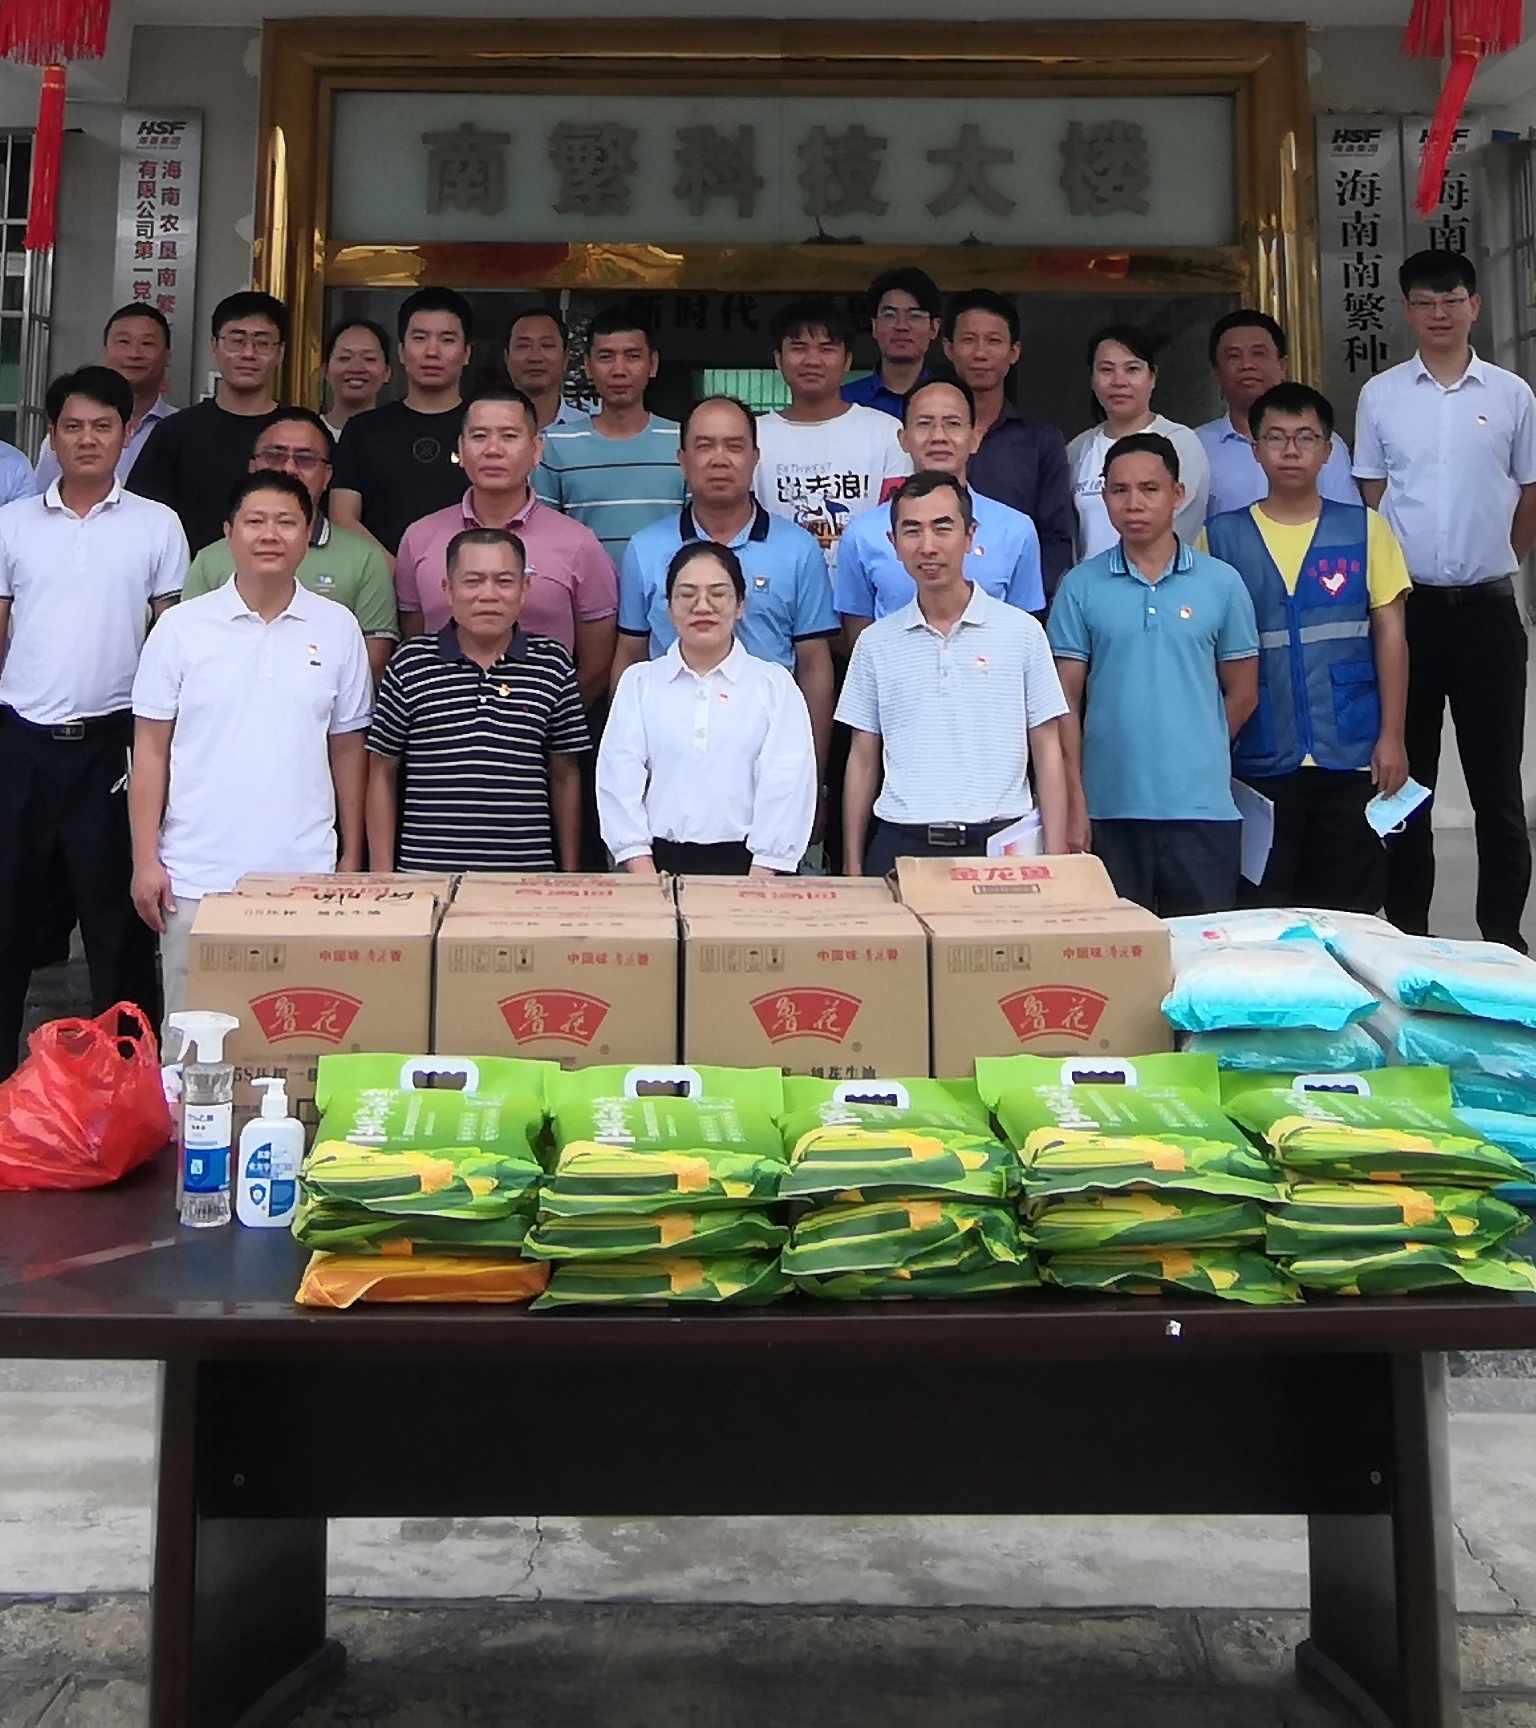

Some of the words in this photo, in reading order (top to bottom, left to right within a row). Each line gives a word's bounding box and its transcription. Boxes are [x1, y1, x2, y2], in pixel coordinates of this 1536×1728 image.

[137, 121, 187, 135] HSF
[1331, 128, 1382, 143] HSF
[421, 121, 1153, 218] 南繁科技大楼
[1335, 169, 1388, 373] 海南南繁种
[268, 995, 341, 1032] 鲁花
[518, 998, 589, 1035] 鲁花
[771, 995, 842, 1032] 鲁花
[1019, 993, 1089, 1030] 鲁花
